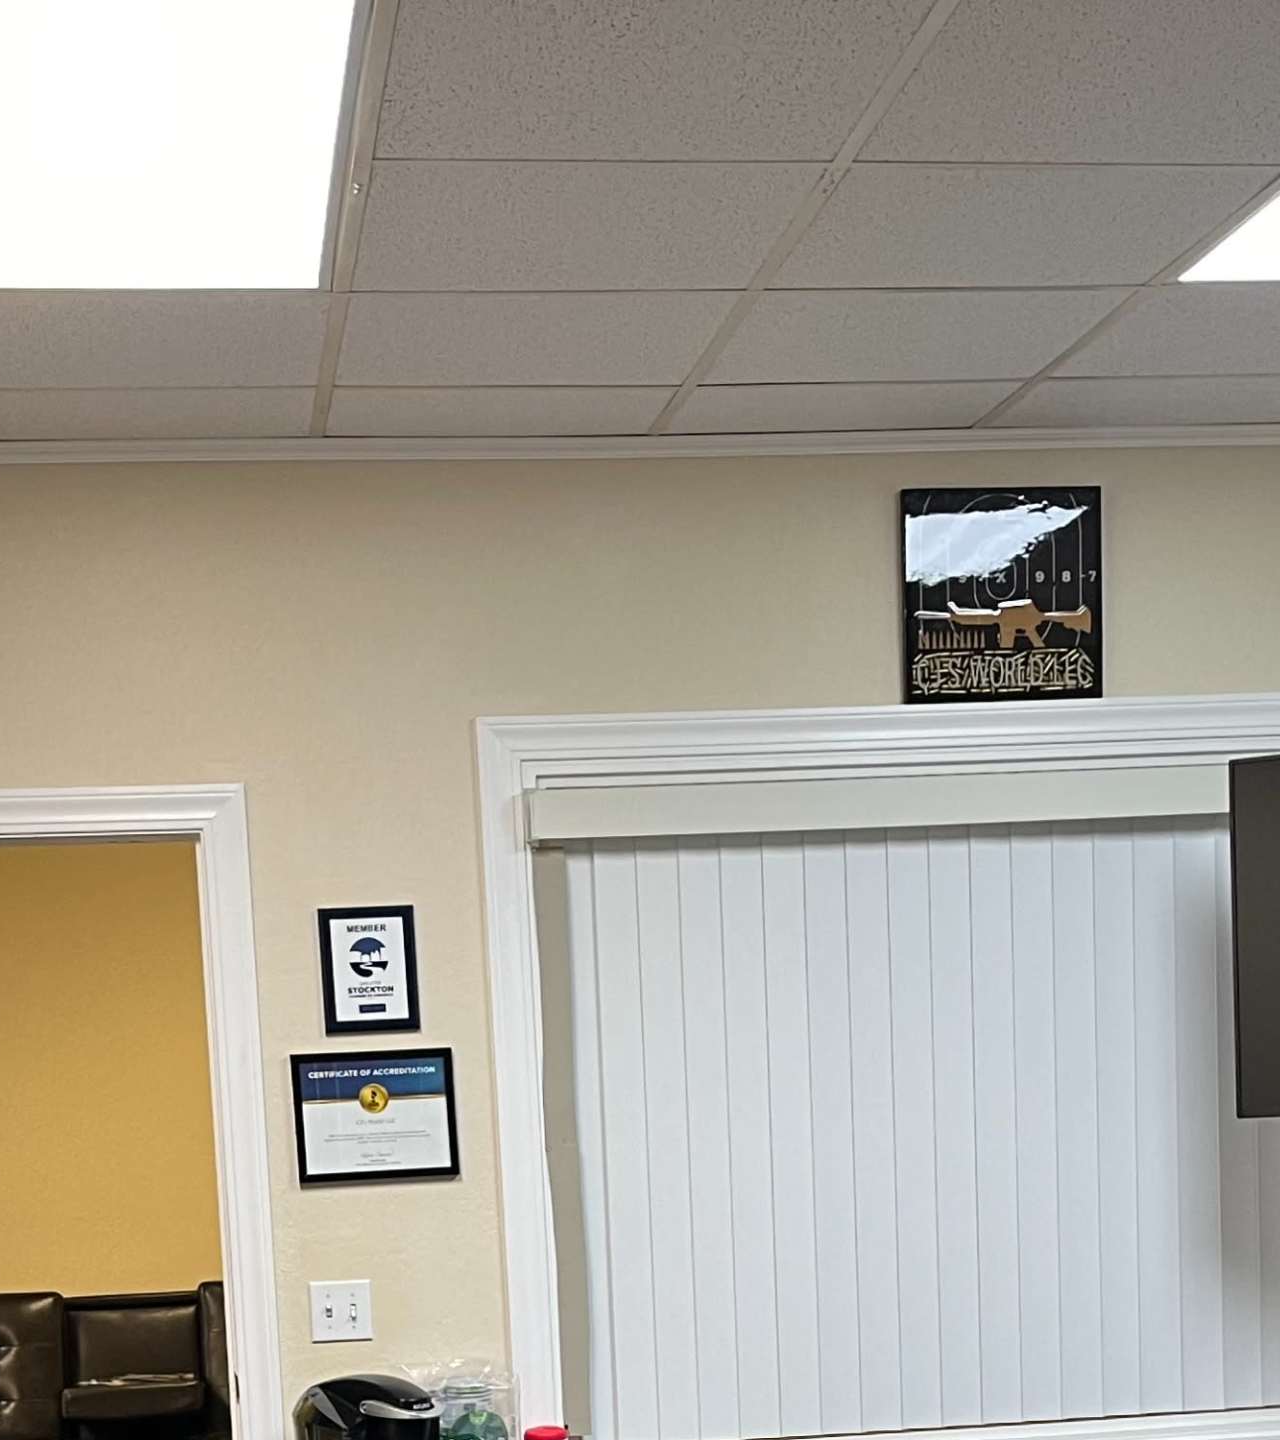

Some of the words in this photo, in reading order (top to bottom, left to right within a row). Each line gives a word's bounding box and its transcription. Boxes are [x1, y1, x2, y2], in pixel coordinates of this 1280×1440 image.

[1035, 571, 1045, 583] 9
[1062, 571, 1072, 583] 8
[1088, 571, 1097, 583] 7
[346, 923, 387, 933] MEMBER
[347, 985, 394, 994] STOCKTON
[308, 1069, 359, 1079] CERTIFICATE
[359, 1069, 371, 1077] OF
[372, 1066, 436, 1076] ACCREDITATION
